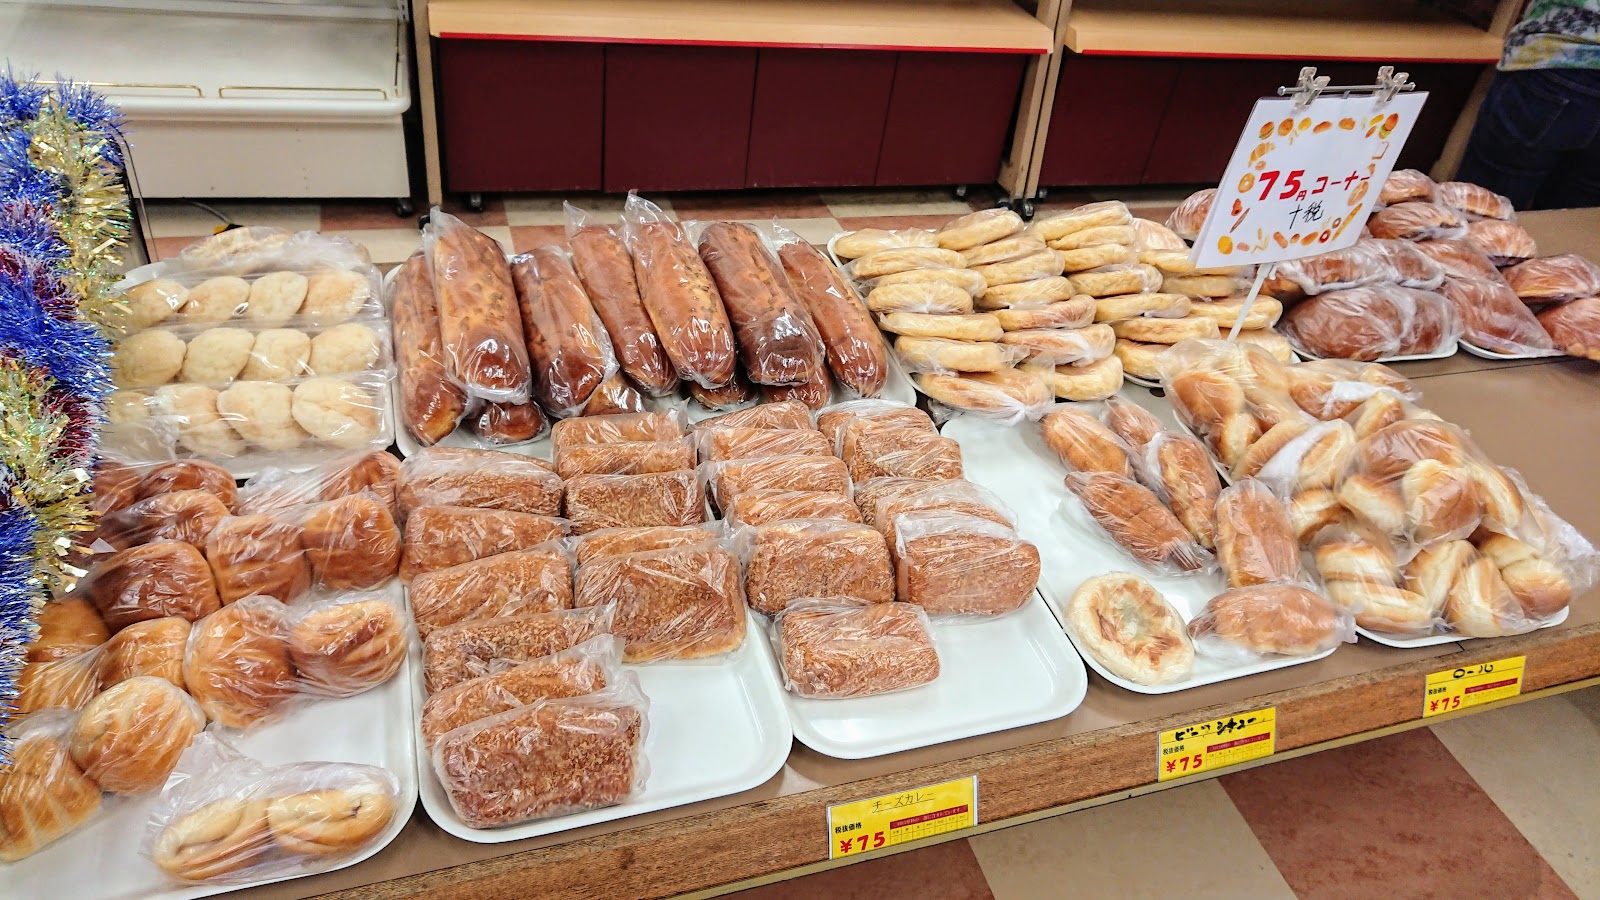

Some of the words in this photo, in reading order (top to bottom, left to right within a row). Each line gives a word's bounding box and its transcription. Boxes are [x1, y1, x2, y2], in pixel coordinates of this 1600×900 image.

[1259, 169, 1371, 201] 75円コーナー
[1430, 695, 1460, 712] ¥75
[1166, 753, 1202, 773] ¥75
[872, 791, 935, 813] チーズカレー
[834, 821, 863, 834] 税抜価格
[840, 831, 886, 853] ¥75
